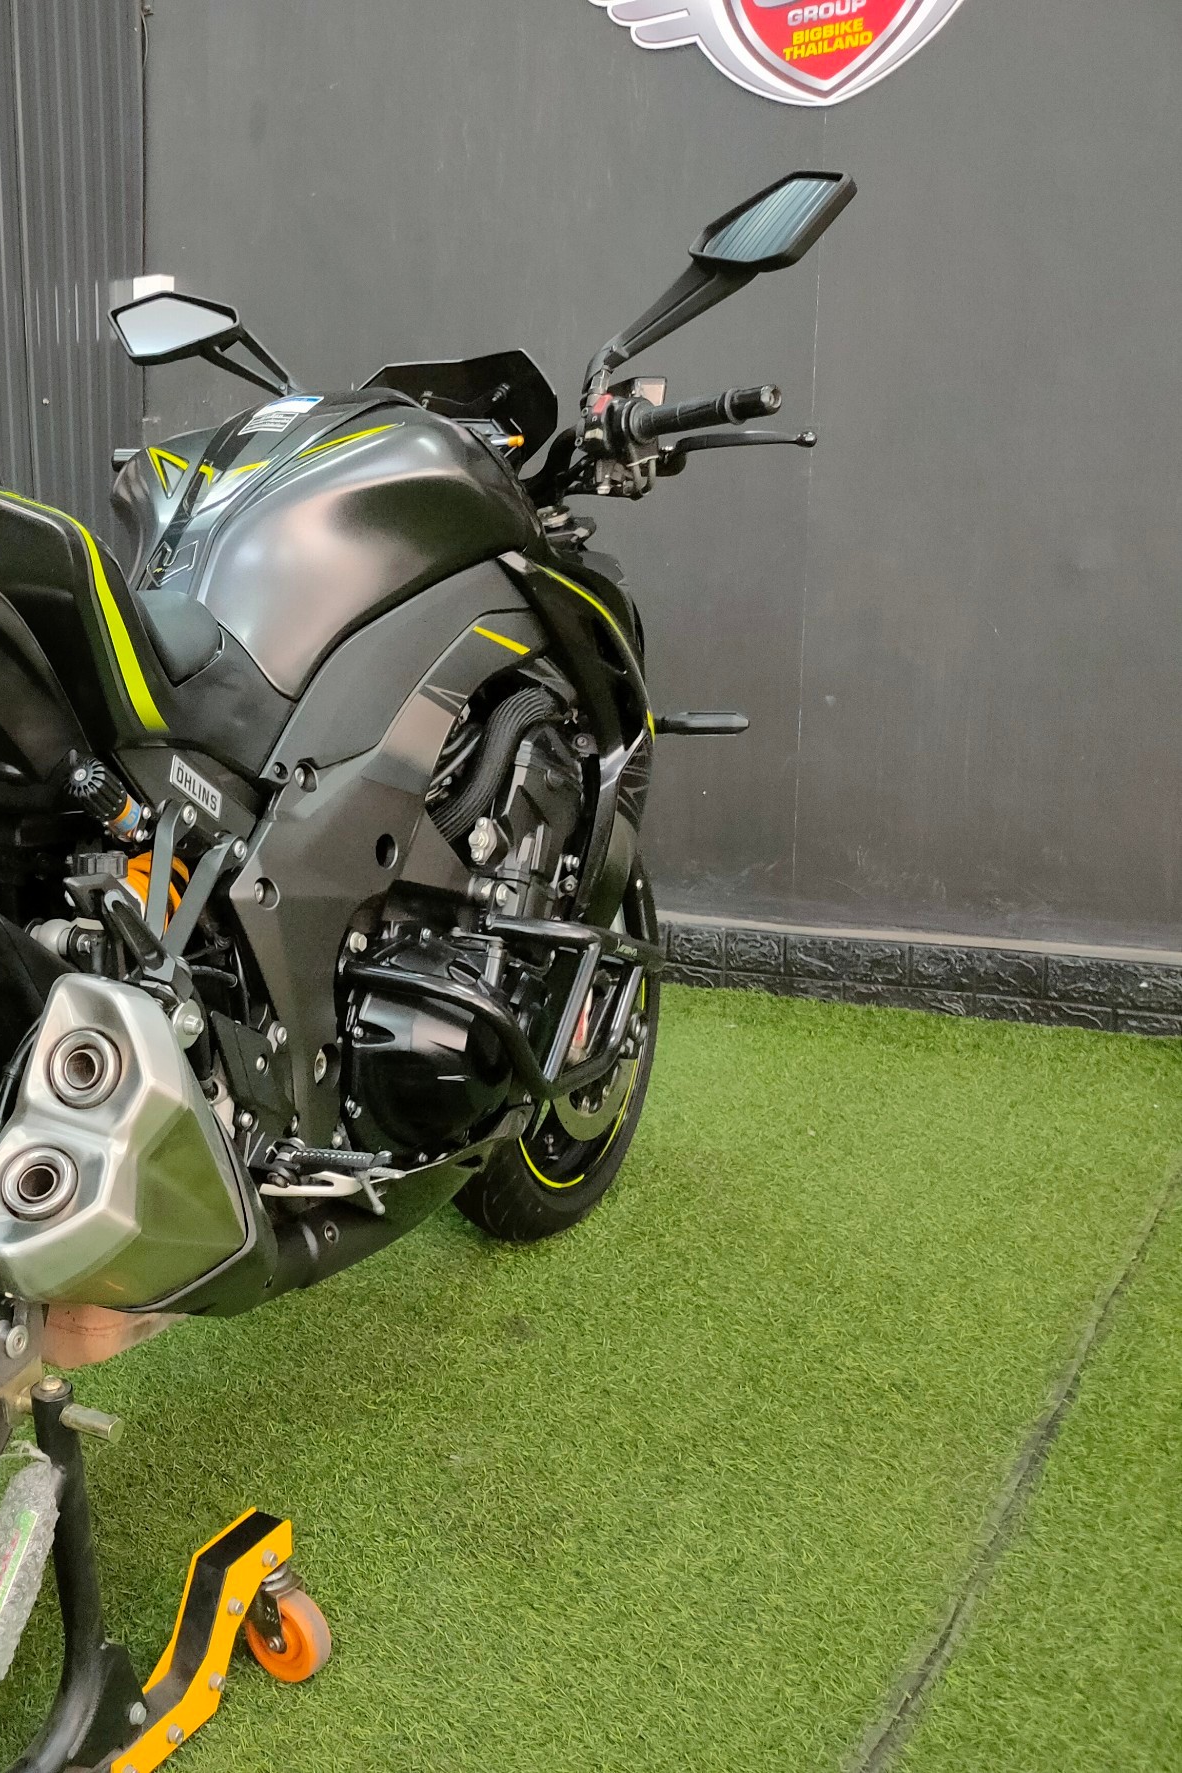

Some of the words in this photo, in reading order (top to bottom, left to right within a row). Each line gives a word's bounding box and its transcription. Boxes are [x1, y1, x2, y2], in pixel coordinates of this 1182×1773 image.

[787, 0, 866, 26] GROUP
[783, 31, 873, 61] THAILAND
[792, 18, 864, 46] BIGBIKE
[176, 761, 218, 812] ÖHLINS
